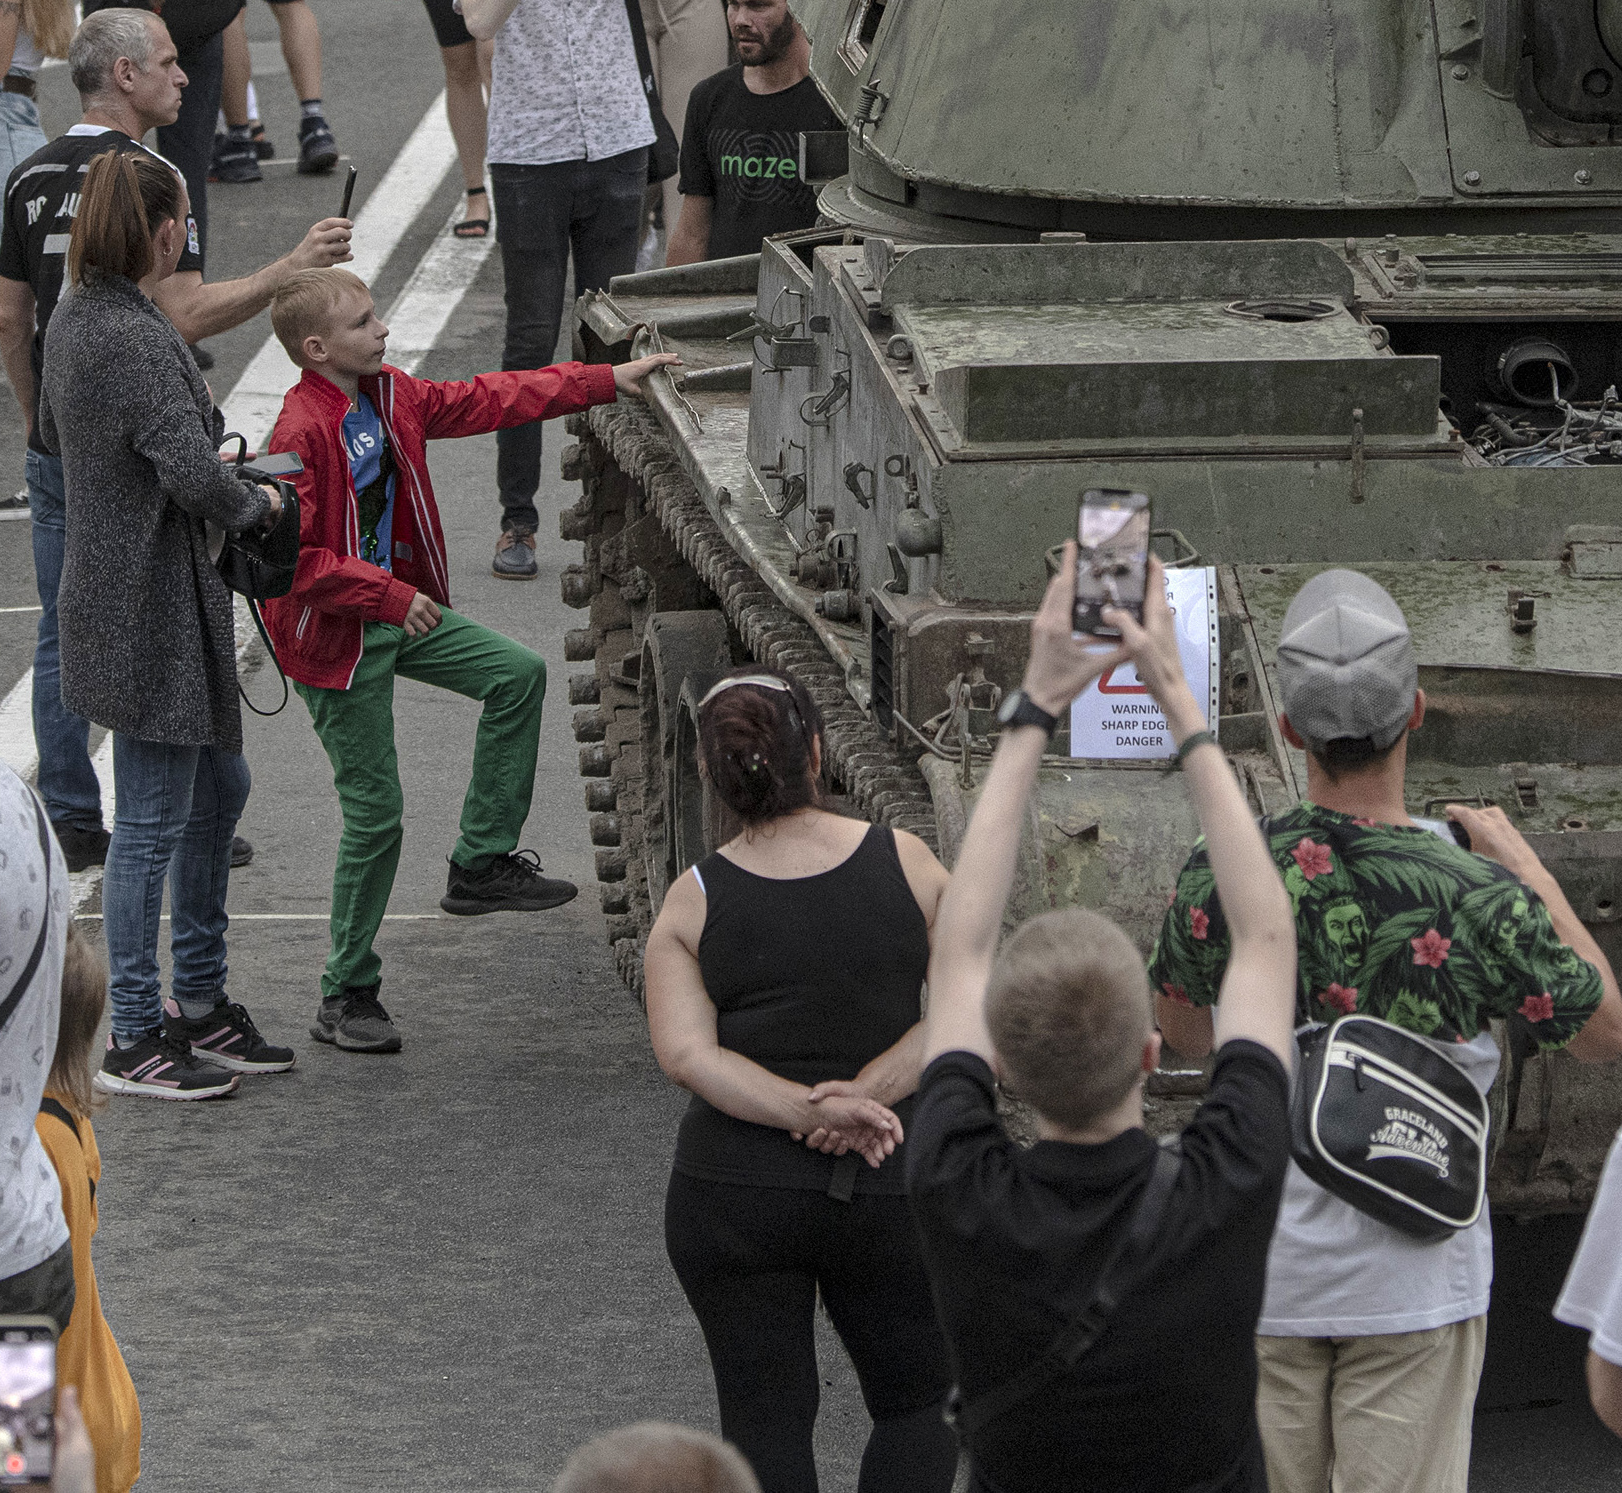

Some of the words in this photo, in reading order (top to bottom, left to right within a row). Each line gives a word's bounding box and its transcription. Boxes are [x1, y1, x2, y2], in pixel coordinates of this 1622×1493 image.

[721, 155, 797, 179] maze
[1101, 720, 1139, 731] SHARP
[1116, 736, 1163, 747] DANGER
[1384, 1107, 1448, 1149] GRACELAND
